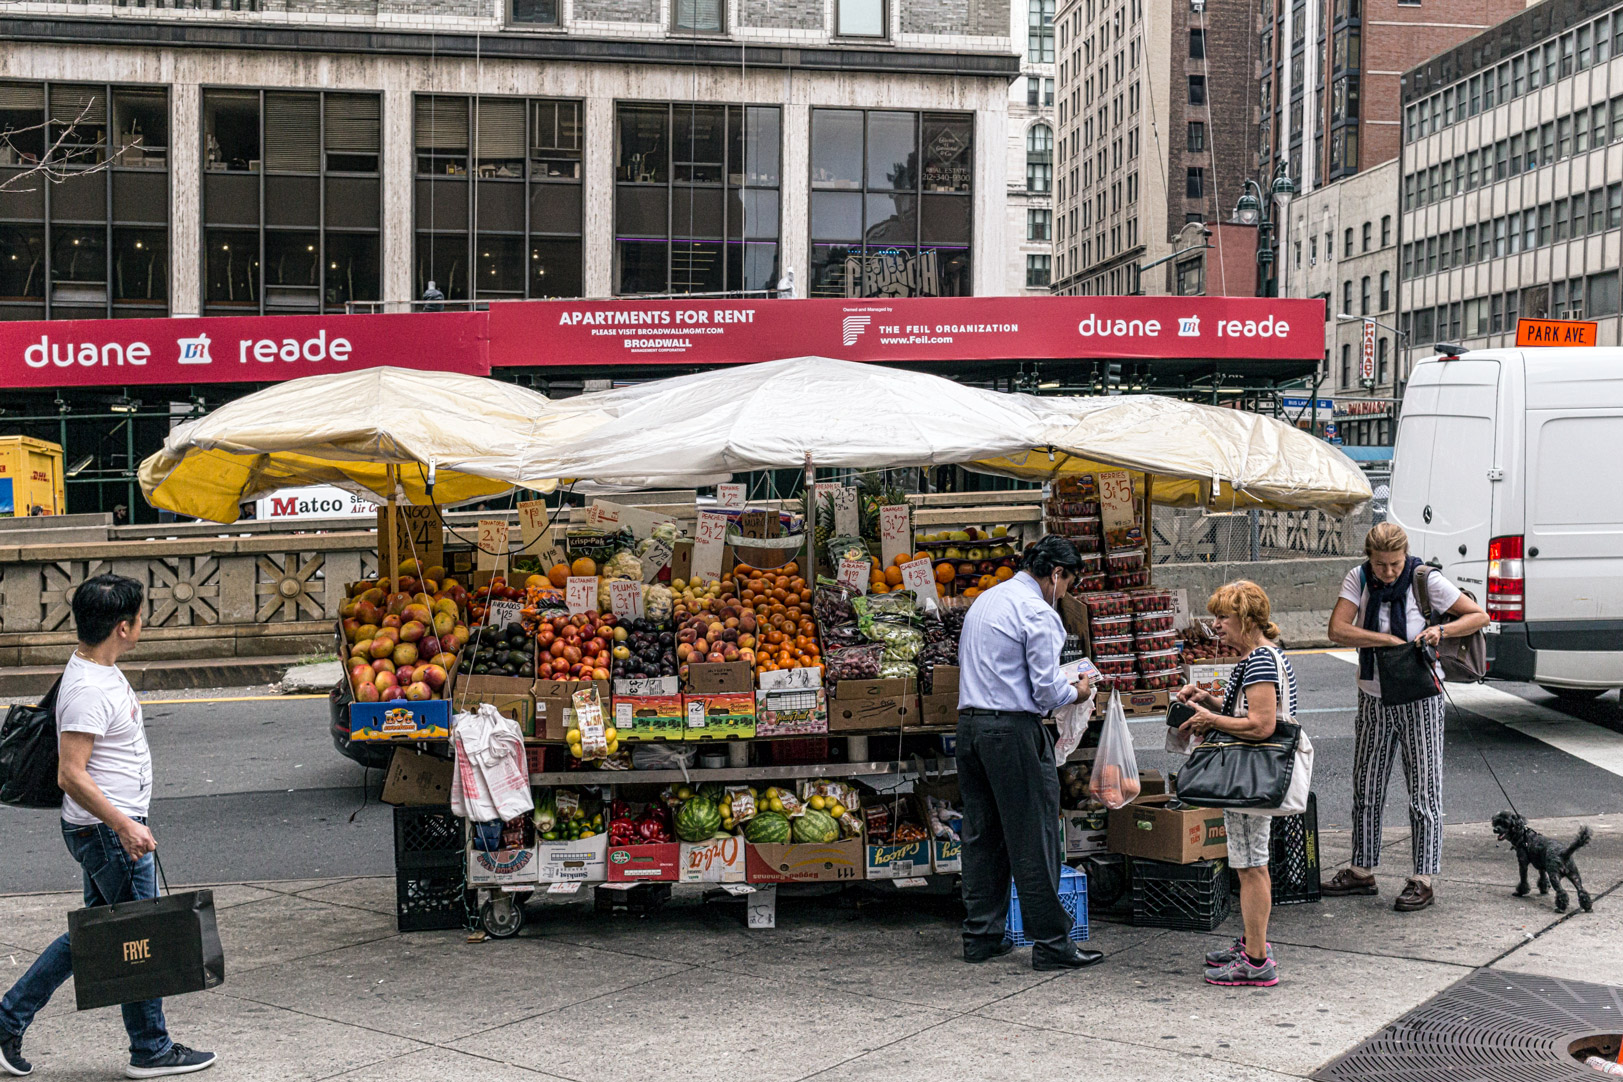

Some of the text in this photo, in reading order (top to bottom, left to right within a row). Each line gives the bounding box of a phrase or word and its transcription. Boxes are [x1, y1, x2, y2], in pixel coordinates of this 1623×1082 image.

[845, 247, 938, 298] CRUNCH
[559, 309, 755, 325] APARTMENTS FOR RENT
[638, 327, 724, 335] BROADWALLMGMT.COM
[879, 324, 1019, 334] THE FEIL ORGANIZATION
[1078, 313, 1162, 337] duane
[1217, 314, 1290, 338] reade
[880, 336, 953, 345] www.Feil.com
[1528, 325, 1560, 342] PARK
[239, 329, 352, 363] reade
[624, 339, 692, 348] BROADWALL
[1364, 323, 1374, 378] PHARMACY
[24, 335, 151, 368] duane
[270, 497, 343, 517] Matco
[351, 504, 366, 514] Air
[702, 513, 725, 521] PEACHES
[841, 563, 867, 571] GRAPES
[612, 583, 638, 592] PLUMS
[492, 601, 520, 609] AVOCADOS
[1208, 825, 1227, 839] me
[495, 851, 534, 875] RIVERSIDE
[560, 871, 588, 880] Sunkist
[123, 939, 151, 961] FRYE
